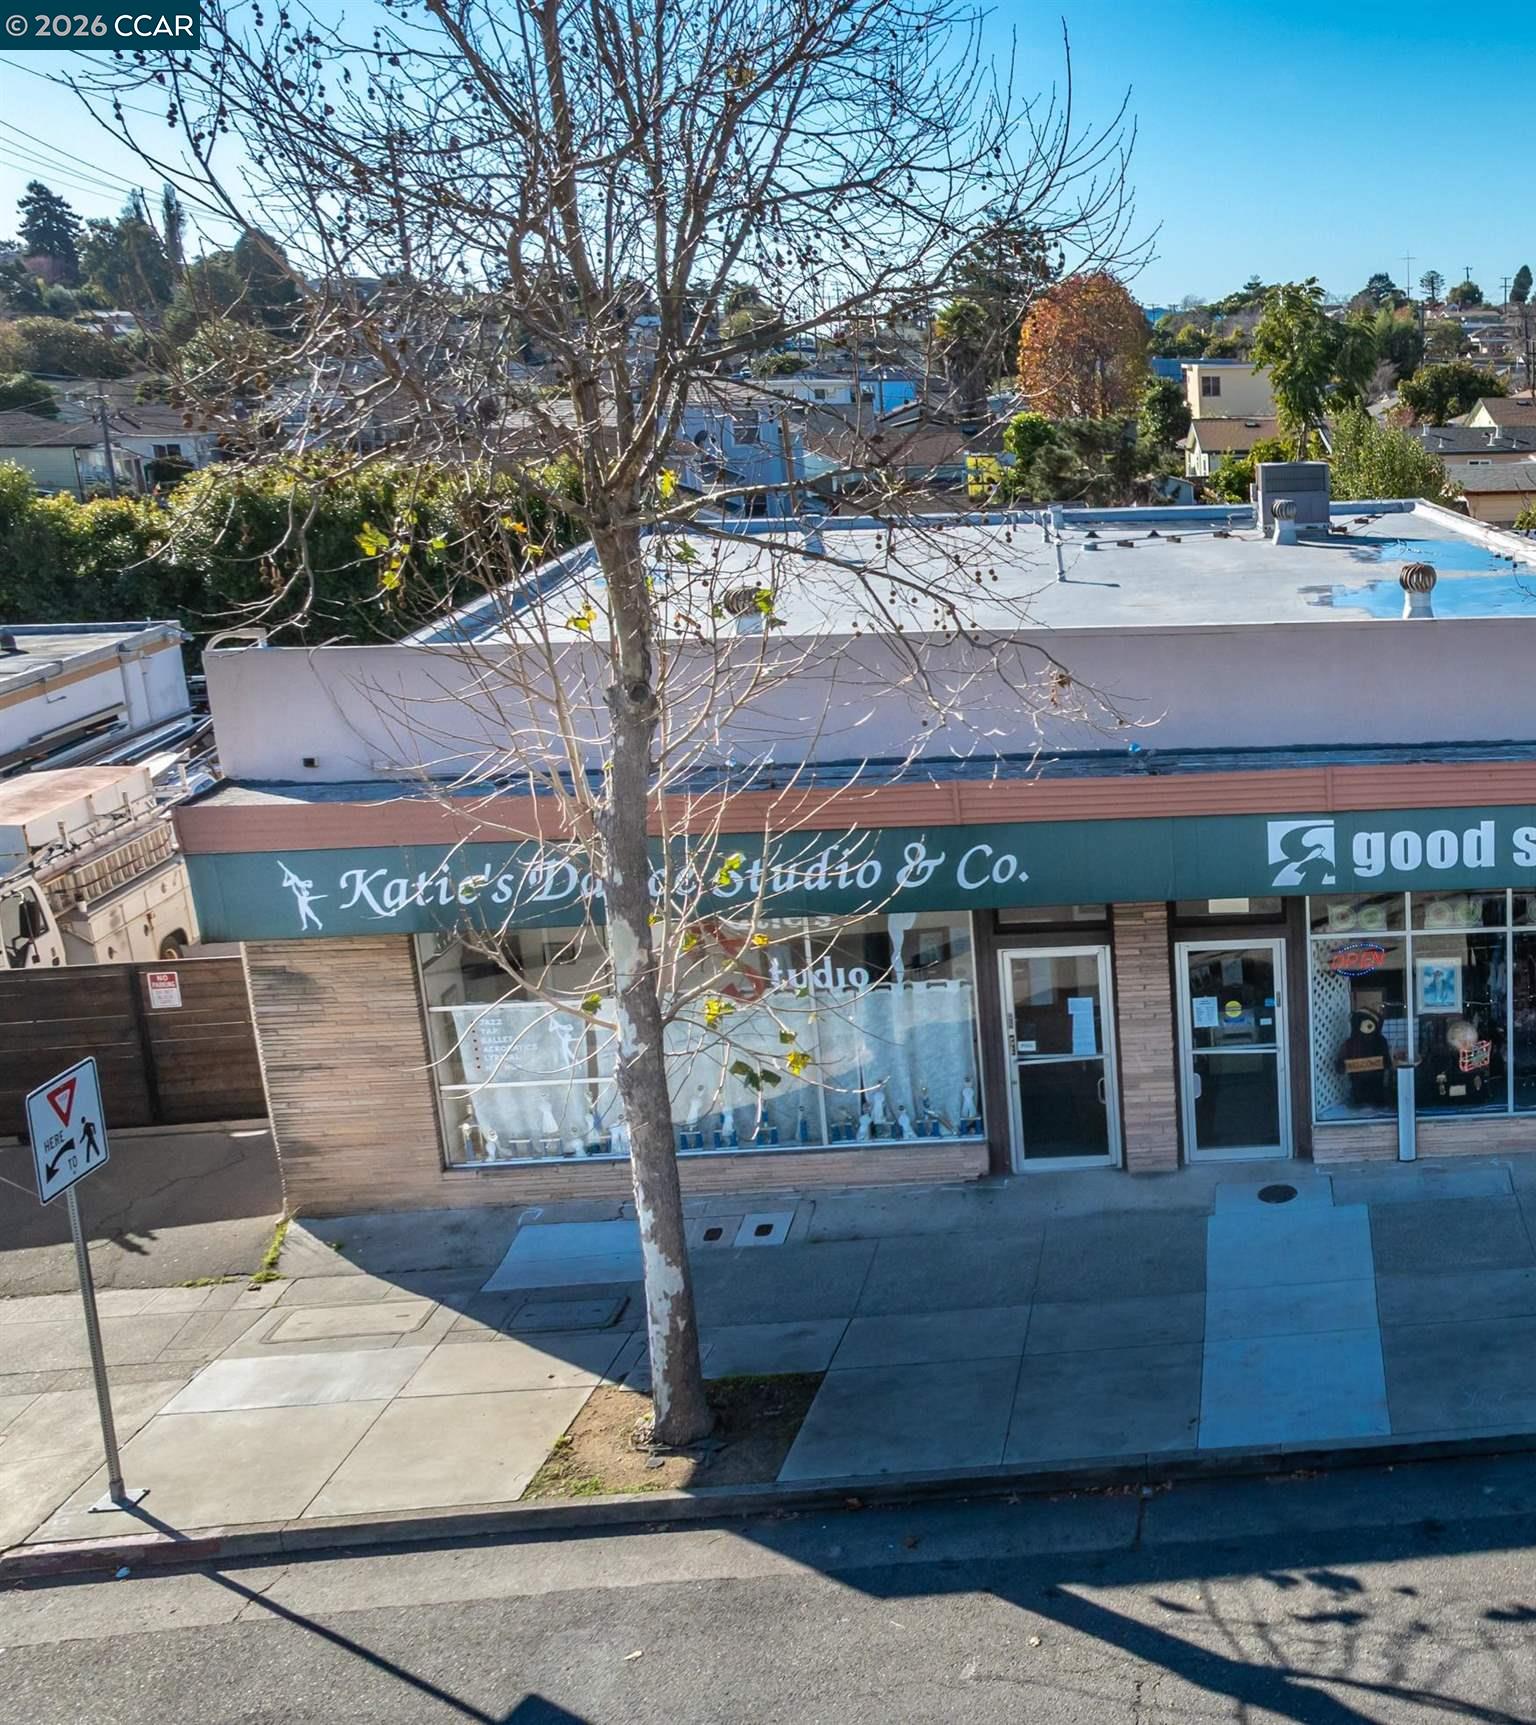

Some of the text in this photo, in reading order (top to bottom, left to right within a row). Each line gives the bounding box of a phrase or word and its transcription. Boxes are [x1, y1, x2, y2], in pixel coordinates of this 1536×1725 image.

[1352, 820, 1496, 877] good
[339, 863, 515, 917] Katie's
[527, 858, 698, 901] Dace
[896, 842, 946, 888] &
[956, 844, 1030, 890] Co.
[1330, 951, 1384, 970] OPEN
[43, 1130, 65, 1152] HERE
[68, 1155, 79, 1171] TO
